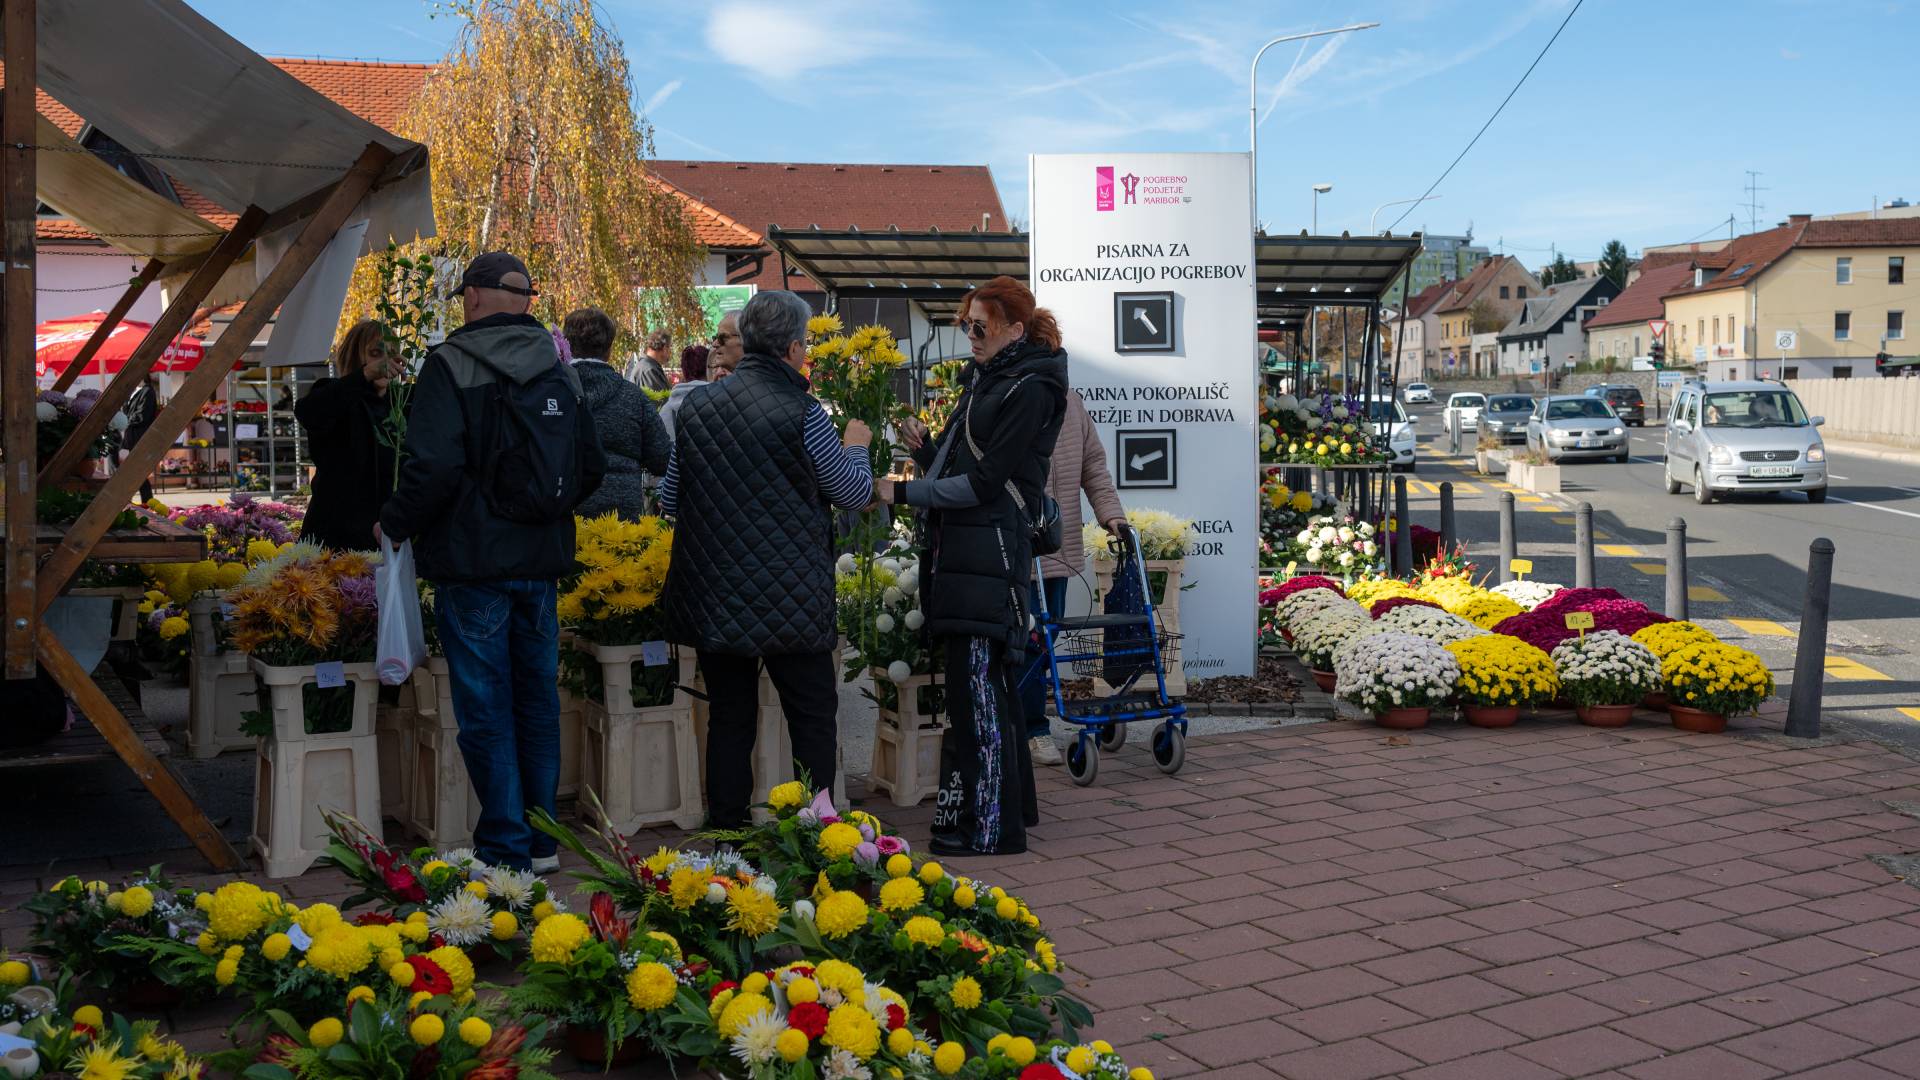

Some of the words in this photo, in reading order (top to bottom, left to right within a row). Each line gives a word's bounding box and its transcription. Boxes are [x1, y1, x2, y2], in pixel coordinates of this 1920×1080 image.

[1143, 175, 1188, 184] POGREBNO
[1143, 186, 1184, 194] PODJETJE
[1143, 196, 1180, 205] MARIBOR
[1096, 243, 1164, 258] PISARNA
[1169, 243, 1190, 257] ZA
[1039, 266, 1156, 284] ORGANIZACIJO
[1161, 265, 1247, 280] POGREBOV
[1072, 387, 1128, 401] SARNA
[1133, 382, 1230, 401] POKOPALIŠČ
[1088, 406, 1132, 427] REŽJE
[1137, 409, 1154, 423] IN
[1159, 408, 1235, 423] DOBRAVA
[1191, 520, 1233, 534] NEGA
